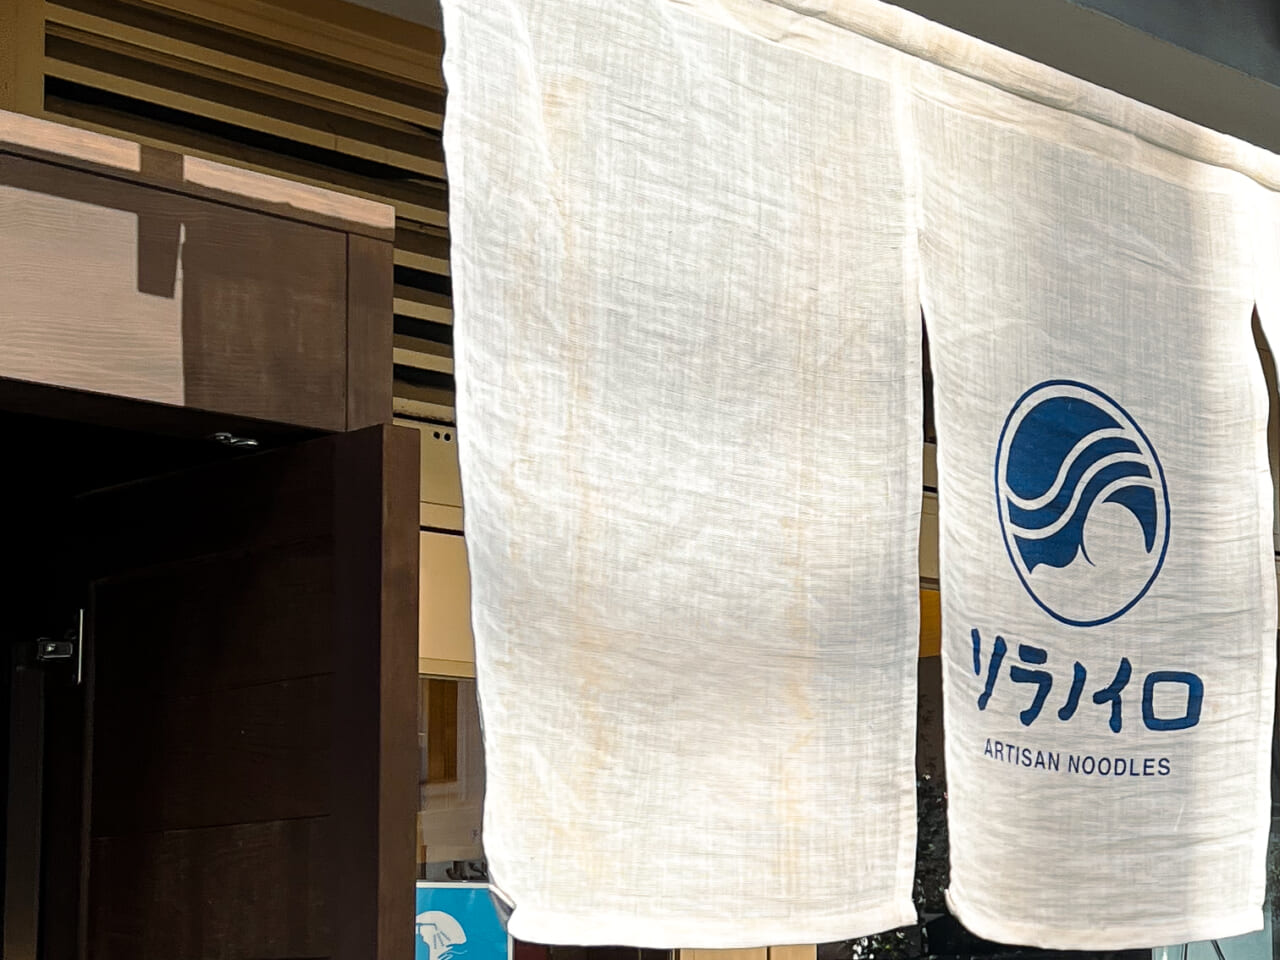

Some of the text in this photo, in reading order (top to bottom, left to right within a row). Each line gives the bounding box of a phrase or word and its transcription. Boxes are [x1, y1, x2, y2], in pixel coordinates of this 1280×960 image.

[970, 627, 1204, 734] ソラノイロ
[984, 738, 1171, 777] ARTISAN NOODLES
